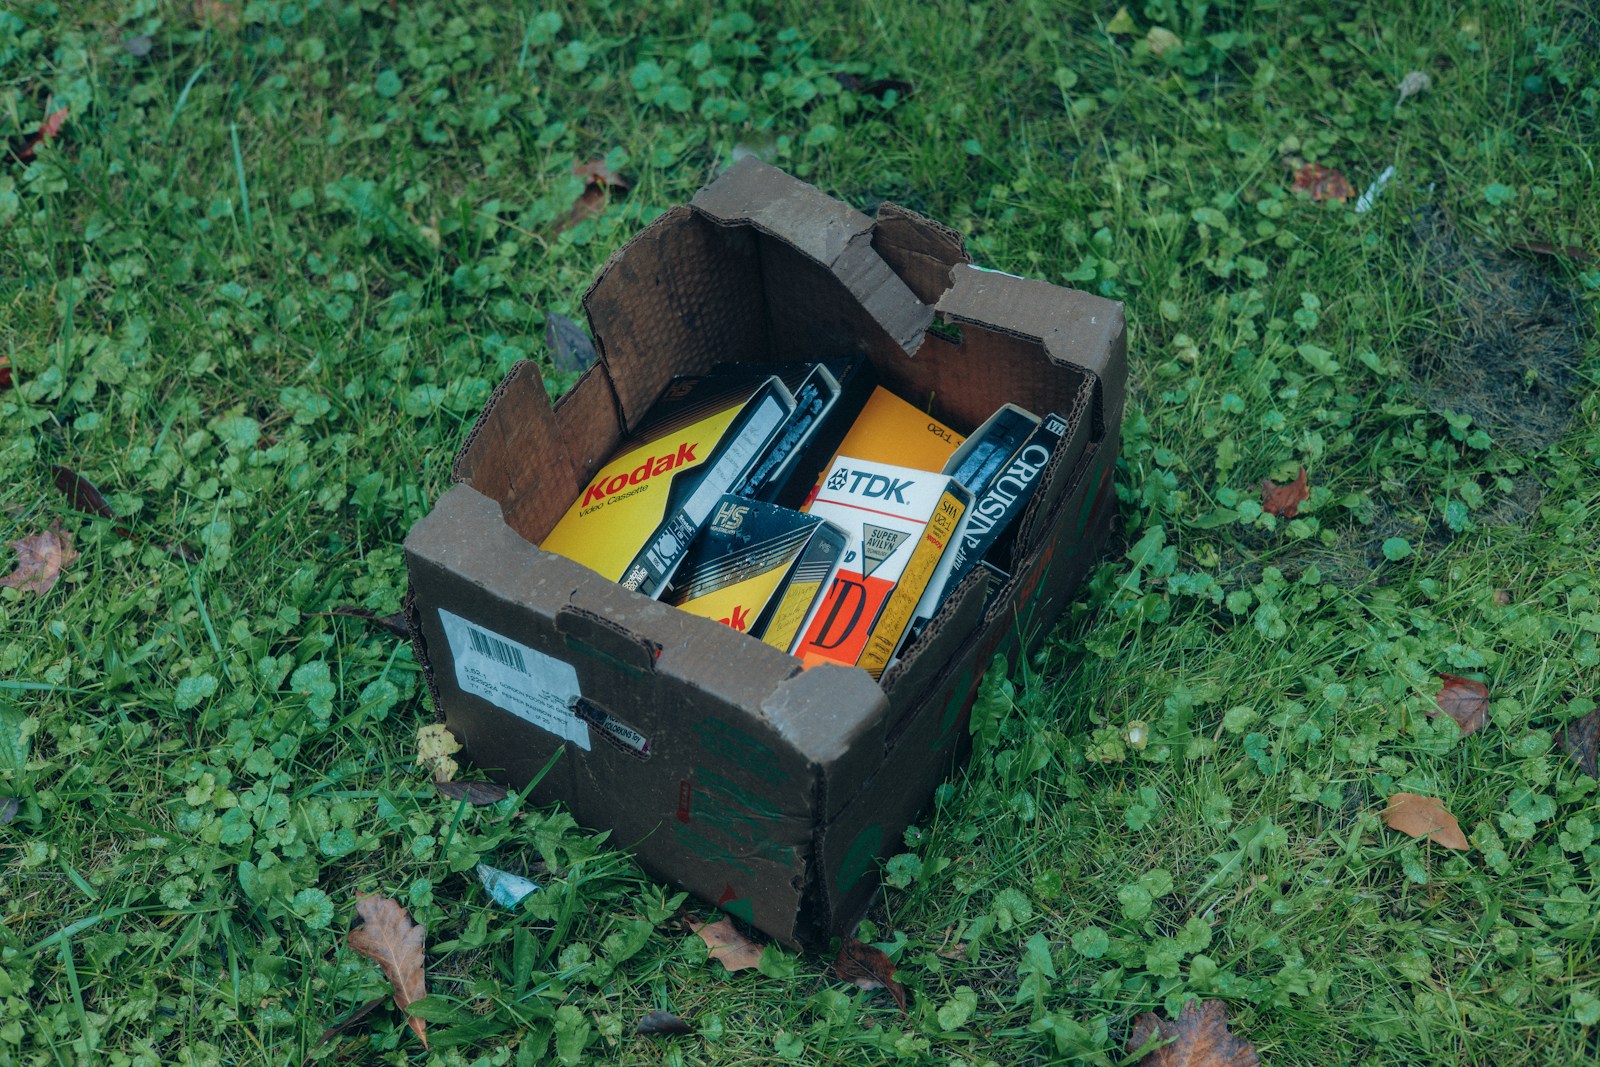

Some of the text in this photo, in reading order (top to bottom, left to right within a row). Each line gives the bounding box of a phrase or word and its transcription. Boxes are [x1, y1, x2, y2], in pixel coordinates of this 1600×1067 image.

[927, 423, 953, 444] T-120
[1047, 420, 1066, 435] VH
[581, 442, 699, 509] Kodak
[848, 470, 916, 505] TDK
[579, 484, 649, 518] Video Cassette
[942, 500, 957, 519] VHS
[712, 501, 750, 530] HS
[866, 537, 896, 552] AVILYN
[871, 529, 899, 543] SUPER
